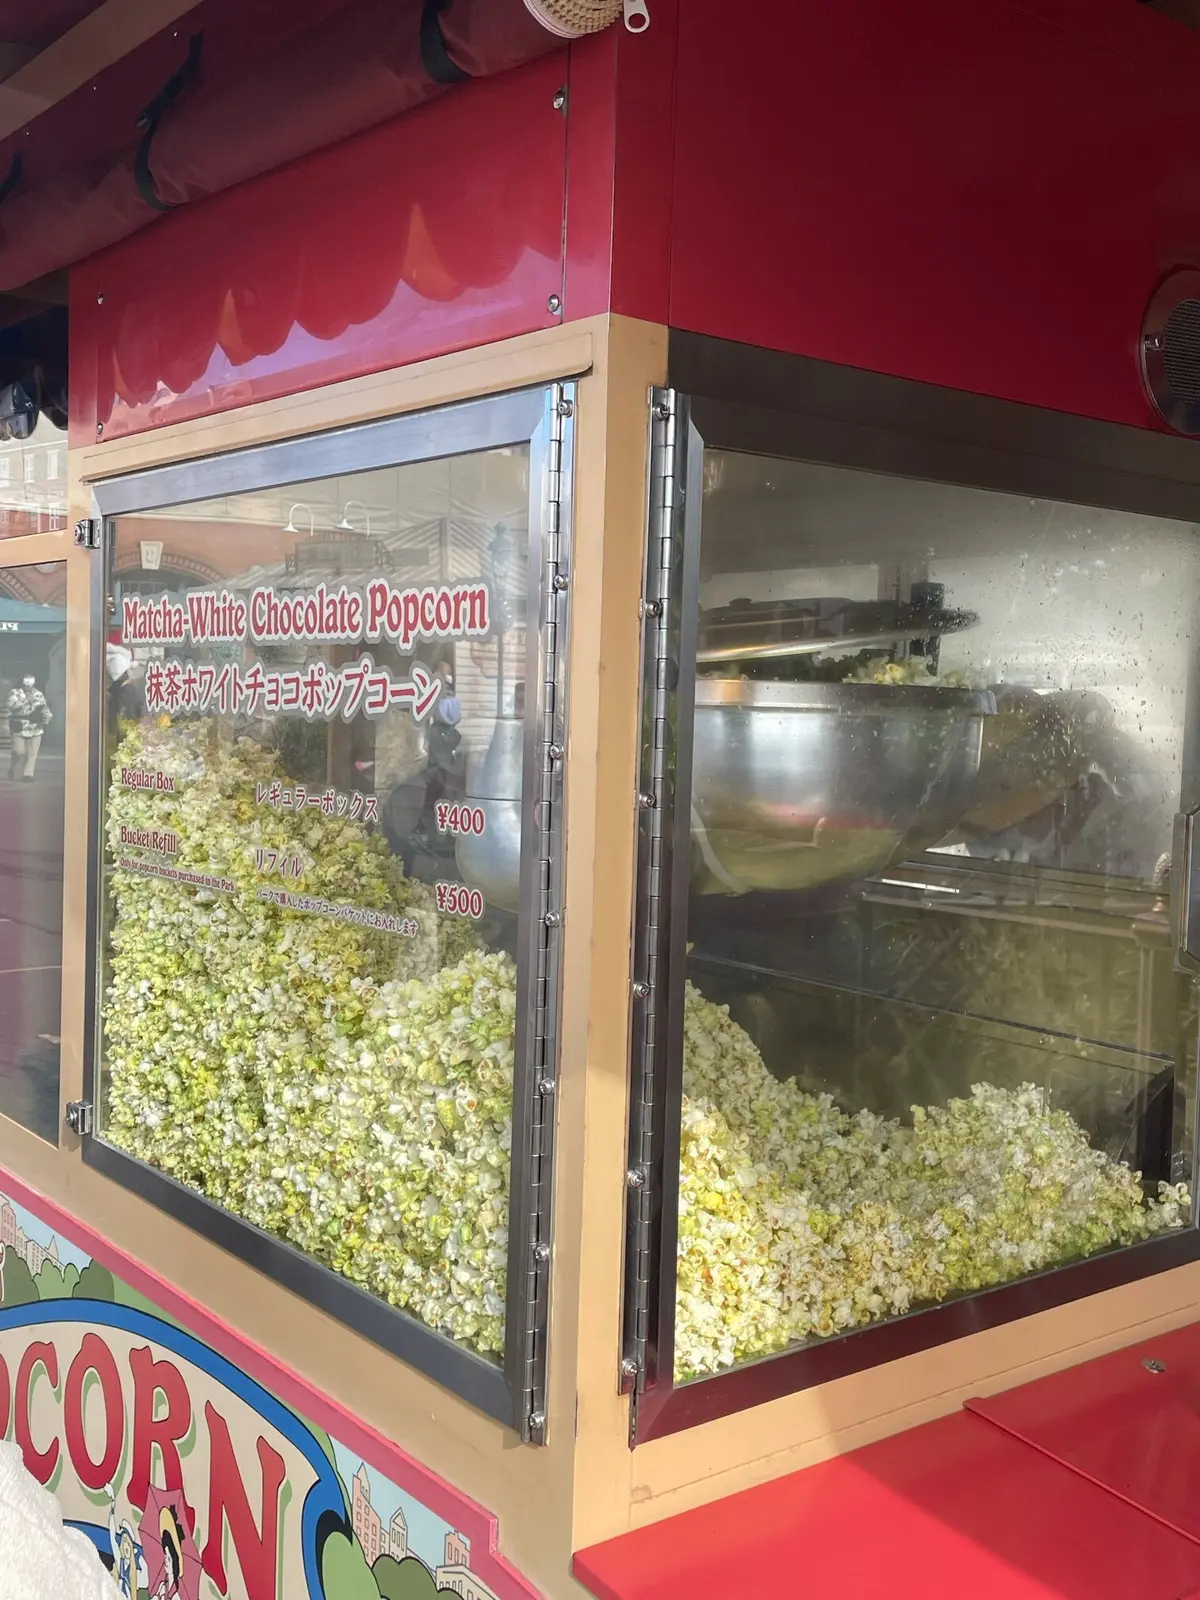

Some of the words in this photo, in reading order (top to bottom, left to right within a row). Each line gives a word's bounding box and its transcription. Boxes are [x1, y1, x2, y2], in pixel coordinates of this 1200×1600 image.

[122, 592, 246, 641] Matcha-White
[251, 585, 361, 636] Chocolate
[367, 581, 488, 645] Popcorn
[145, 660, 441, 717] 抹茶ホワイトチョコポップコーン
[120, 767, 155, 790] Regular
[156, 771, 175, 791] Box
[436, 803, 485, 834] ¥400
[120, 825, 150, 848] Bucket
[152, 831, 177, 855] Refill
[131, 859, 139, 870] for
[139, 862, 158, 875] popcorn
[159, 866, 178, 879] buckets
[178, 870, 205, 885] purchased
[204, 875, 211, 885] in
[211, 876, 221, 887] the
[221, 879, 235, 892] Park
[255, 848, 302, 878] リフィル
[436, 883, 484, 917] ¥500
[0, 1333, 287, 1600] CORN
